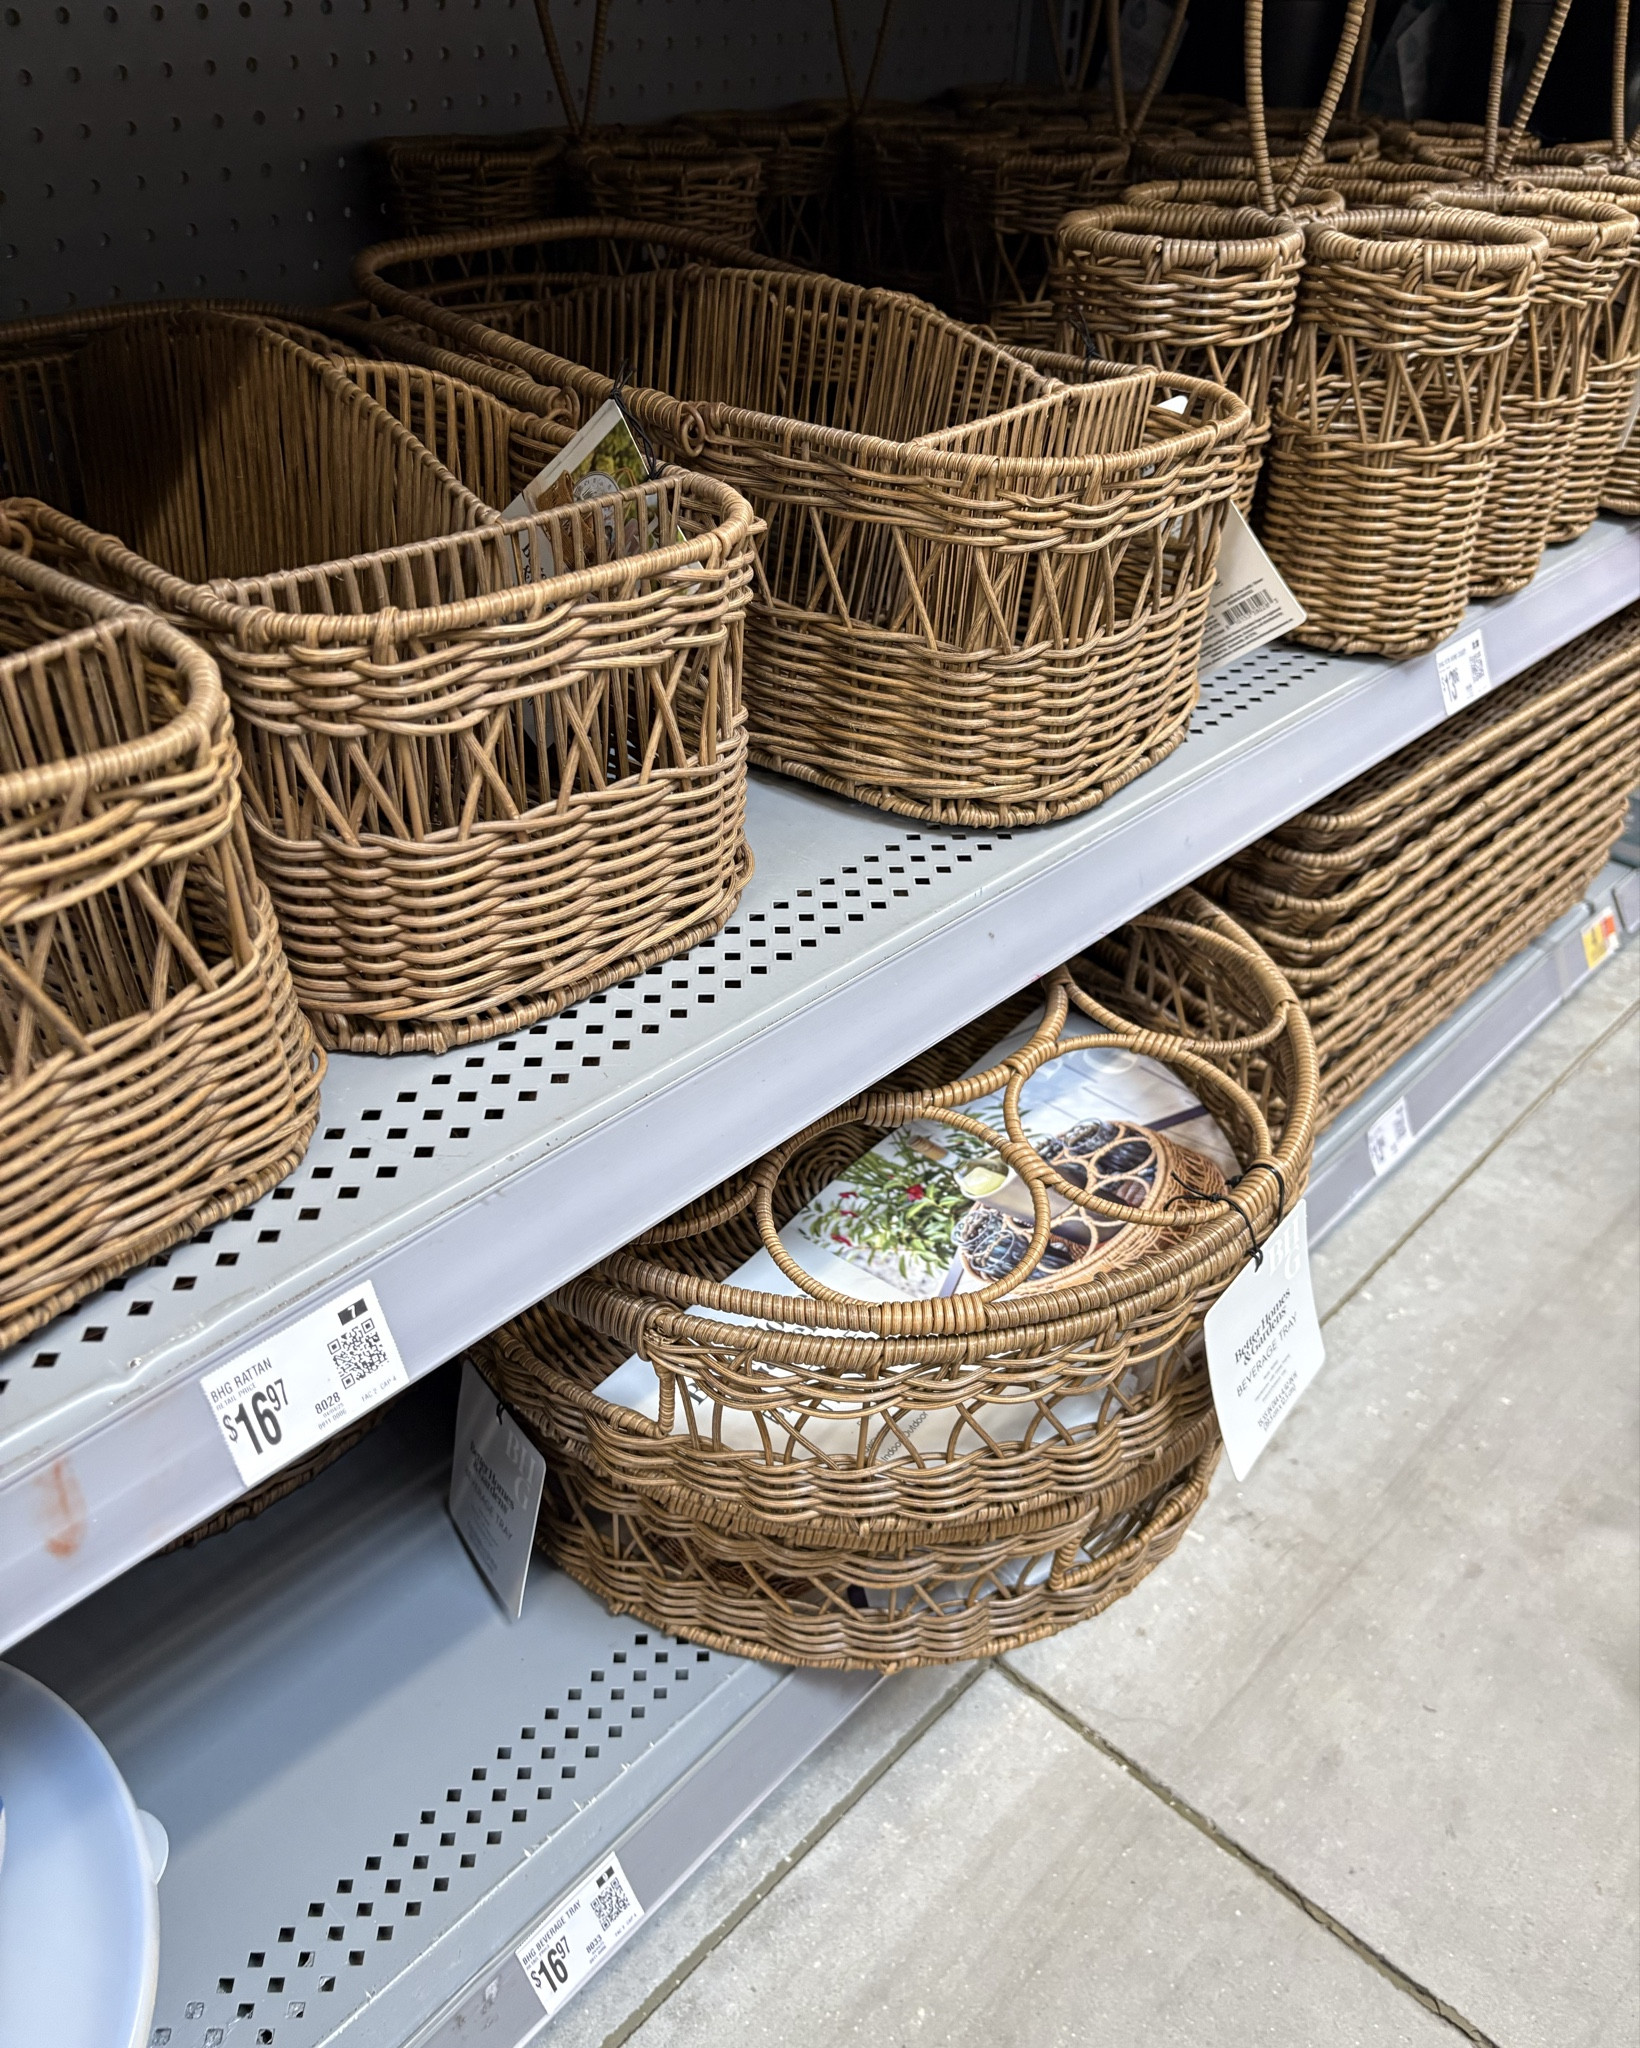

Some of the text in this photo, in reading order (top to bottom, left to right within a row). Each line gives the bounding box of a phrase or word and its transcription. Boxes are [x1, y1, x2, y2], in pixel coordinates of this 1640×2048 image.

[348, 1305, 358, 1319] 7
[1234, 1323, 1262, 1366] Better
[1260, 1286, 1291, 1330] Homes
[1250, 1305, 1286, 1357] Gardens
[210, 1357, 273, 1404] BHG RATTAN
[1236, 1339, 1279, 1398] BEVERAGE
[1278, 1311, 1298, 1343] TRAY
[314, 1392, 341, 1415] 8028
[522, 1900, 582, 1966] BHG BEVERAGE TRAY
